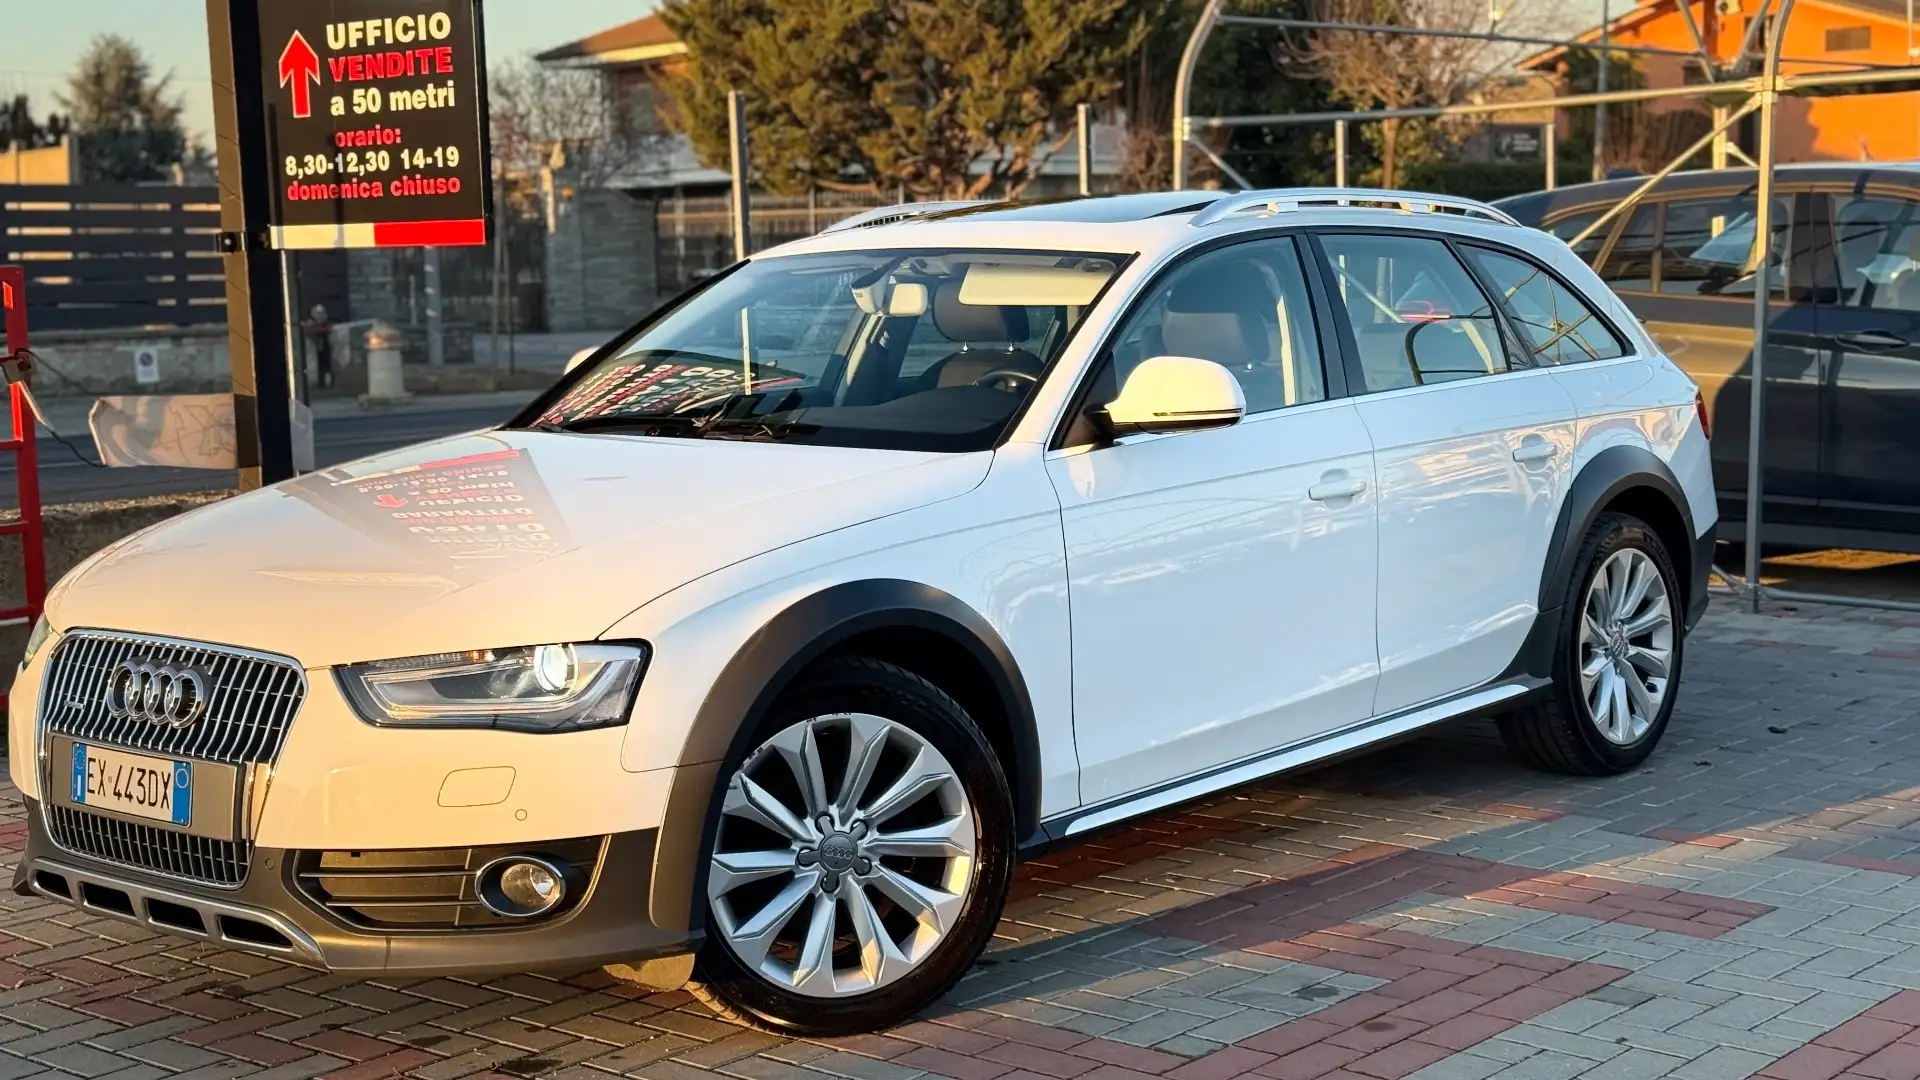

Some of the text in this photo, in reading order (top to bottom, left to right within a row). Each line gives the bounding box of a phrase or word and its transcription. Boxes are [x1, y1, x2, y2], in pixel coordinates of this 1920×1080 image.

[326, 12, 451, 50] UFFICIO
[327, 46, 454, 82] VENDITE
[330, 79, 455, 116] a 50 metri
[335, 124, 402, 148] orario:
[285, 146, 460, 179] 8,30-12,30 14-19
[287, 173, 461, 201] domenica chiuso
[87, 757, 171, 810] EX 443DX
